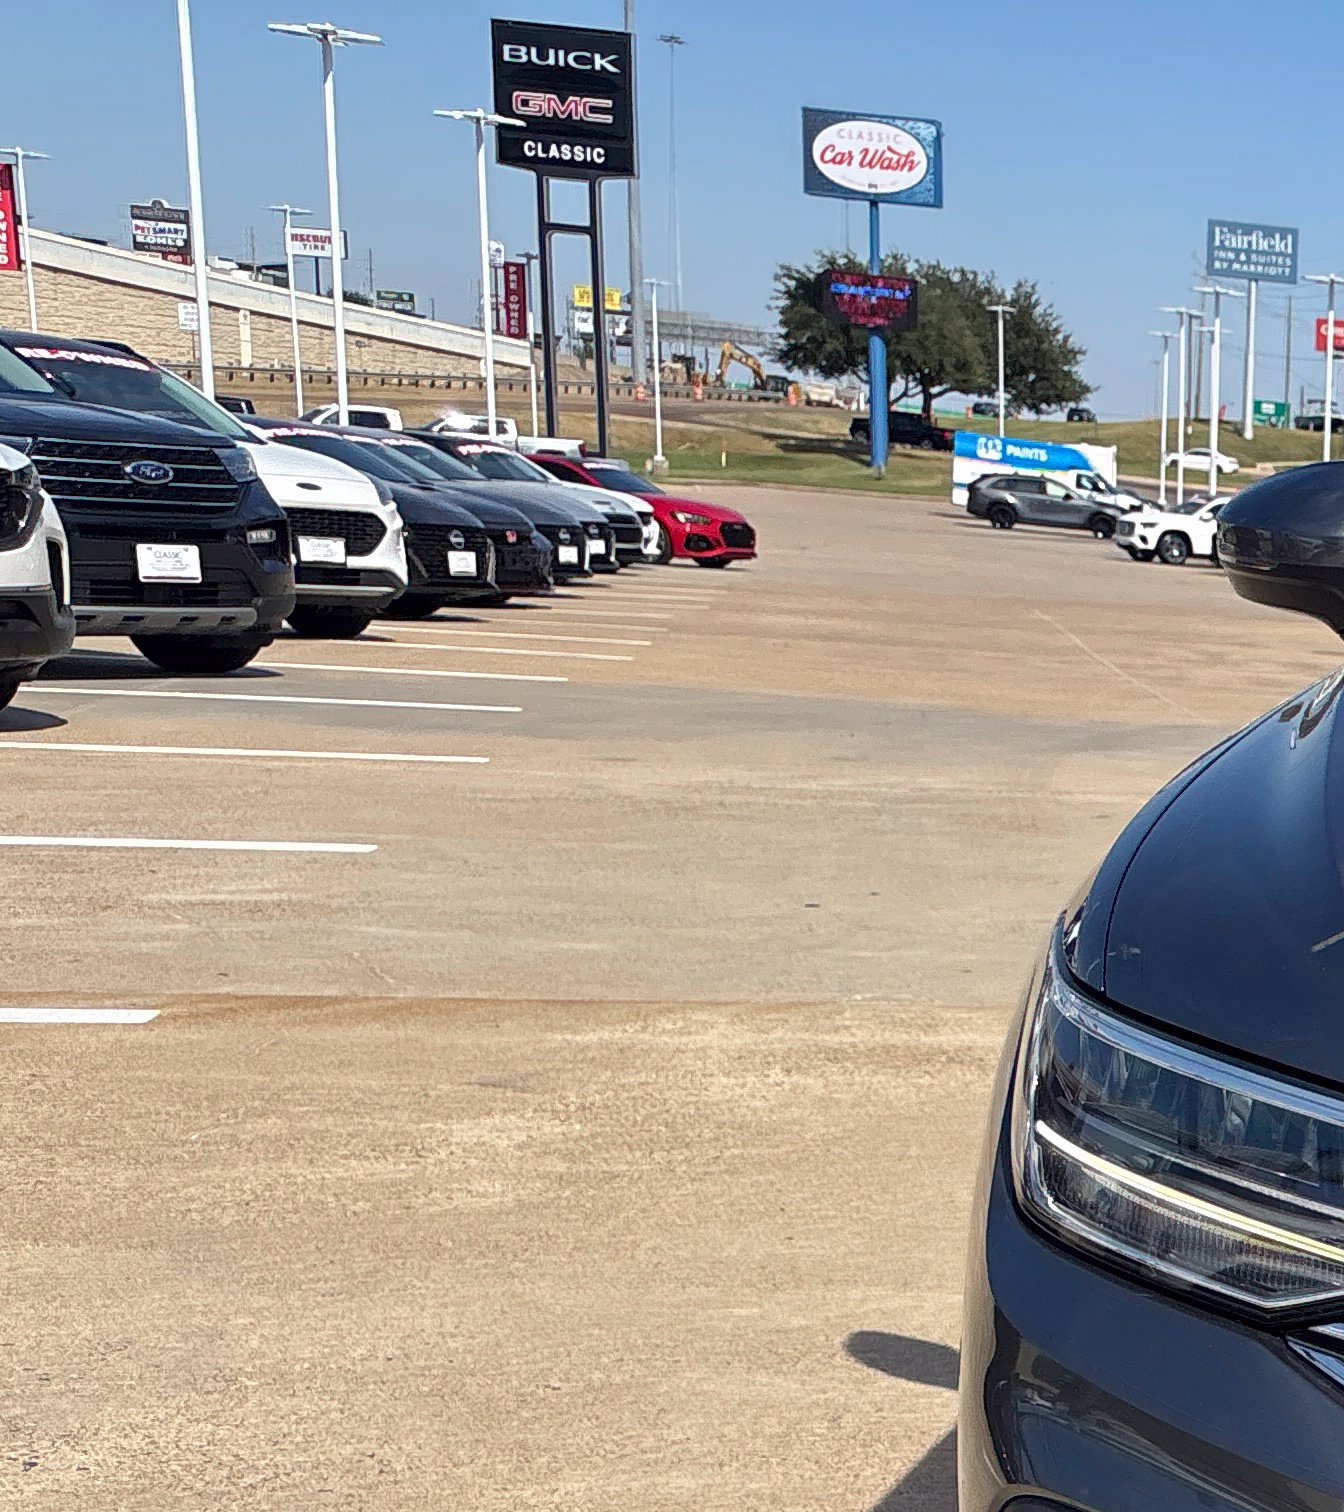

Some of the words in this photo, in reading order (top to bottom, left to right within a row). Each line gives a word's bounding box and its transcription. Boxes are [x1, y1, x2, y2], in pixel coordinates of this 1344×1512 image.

[502, 43, 621, 74] BUICK
[512, 90, 614, 124] GMC
[836, 128, 903, 145] CLASSIC
[523, 140, 606, 164] CLASSIC
[820, 143, 855, 167] Car
[858, 145, 921, 173] Wash
[1214, 225, 1293, 254] Fairfield
[1231, 262, 1292, 277] MARRIOTT
[1250, 253, 1293, 266] SUITES
